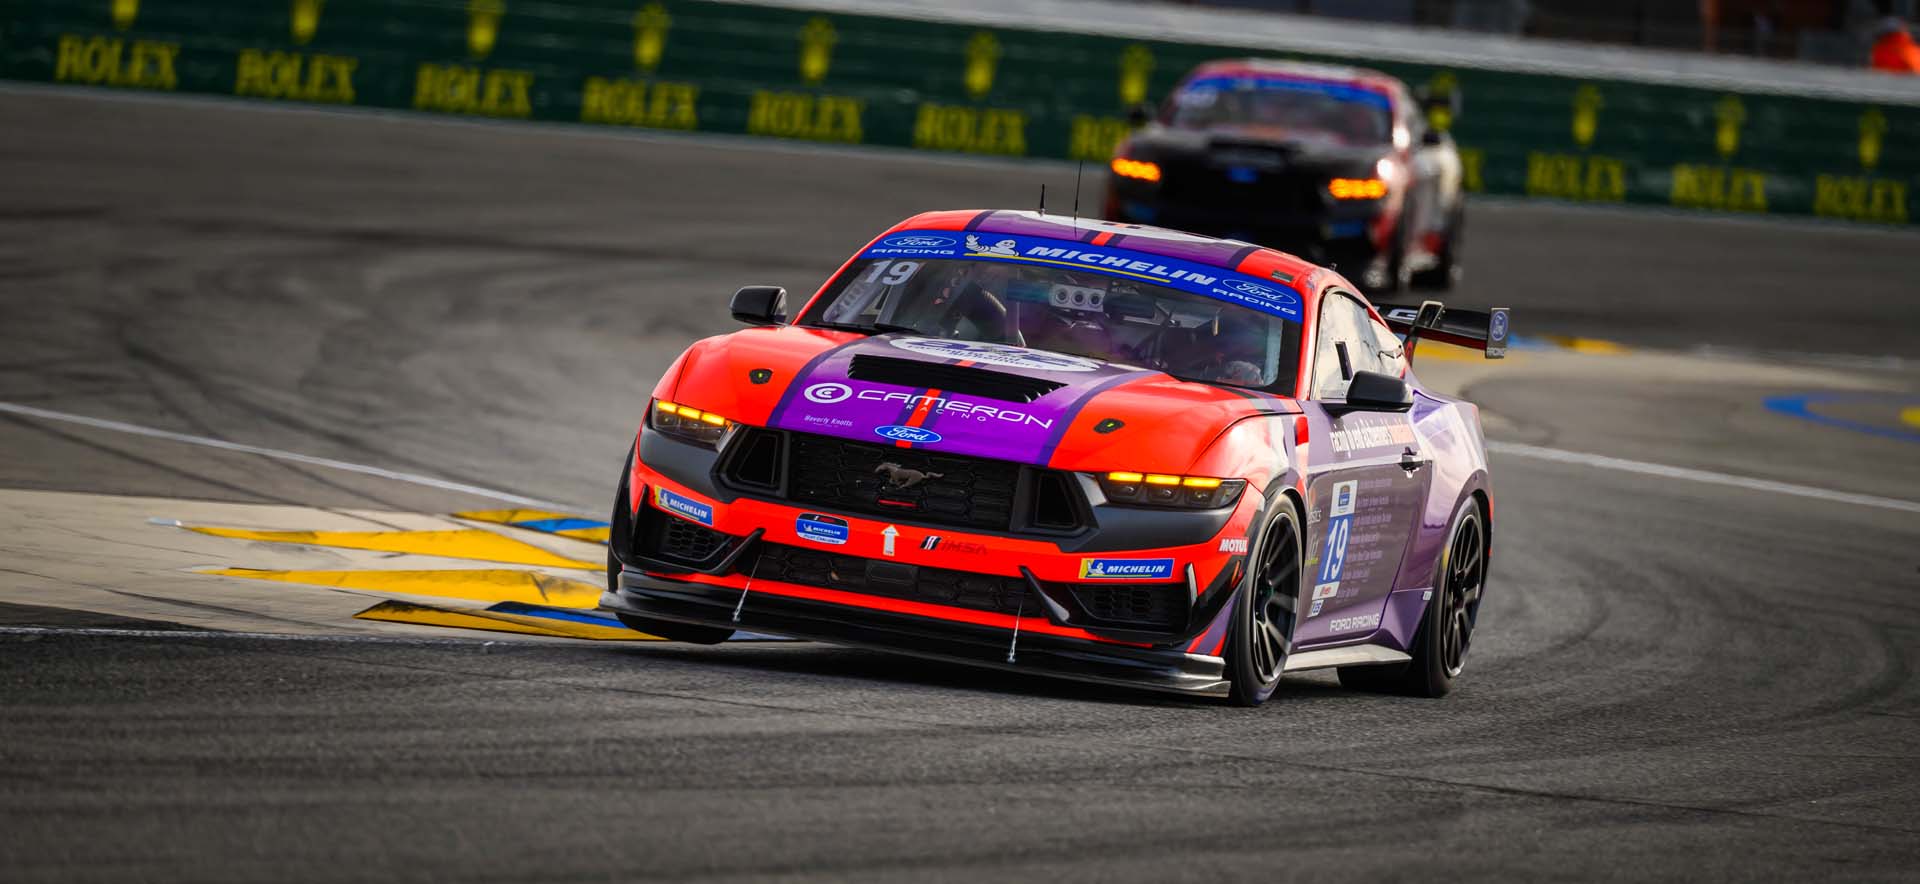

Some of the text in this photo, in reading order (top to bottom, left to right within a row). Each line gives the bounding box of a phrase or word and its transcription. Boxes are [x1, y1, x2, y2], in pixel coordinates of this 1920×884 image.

[57, 36, 179, 88] ROLEX
[236, 49, 357, 101] ROLEX
[415, 64, 533, 117] ROLEX
[582, 77, 697, 130] ROLEX
[748, 91, 864, 143] ROLEX
[915, 104, 1027, 155] ROLEX
[1527, 153, 1626, 200] ROLEX
[1671, 164, 1767, 212] ROLEX
[1814, 175, 1907, 222] ROLEX
[896, 237, 943, 246] Ford
[864, 259, 922, 286] 19
[1026, 246, 1217, 286] MICHELIN
[1212, 288, 1298, 316] RACING
[1237, 282, 1282, 301] Ford
[857, 389, 1054, 430] CAMERON
[906, 404, 987, 421] RACING
[886, 427, 930, 441] Ford
[669, 498, 708, 519] MICHELIN
[813, 527, 841, 535] MICHELIN
[941, 541, 988, 555] IMSA
[1219, 538, 1249, 552] MOTUL
[1322, 518, 1349, 581] 19
[1106, 564, 1165, 574] MICHELIN
[1329, 613, 1380, 633] FORD RACING
